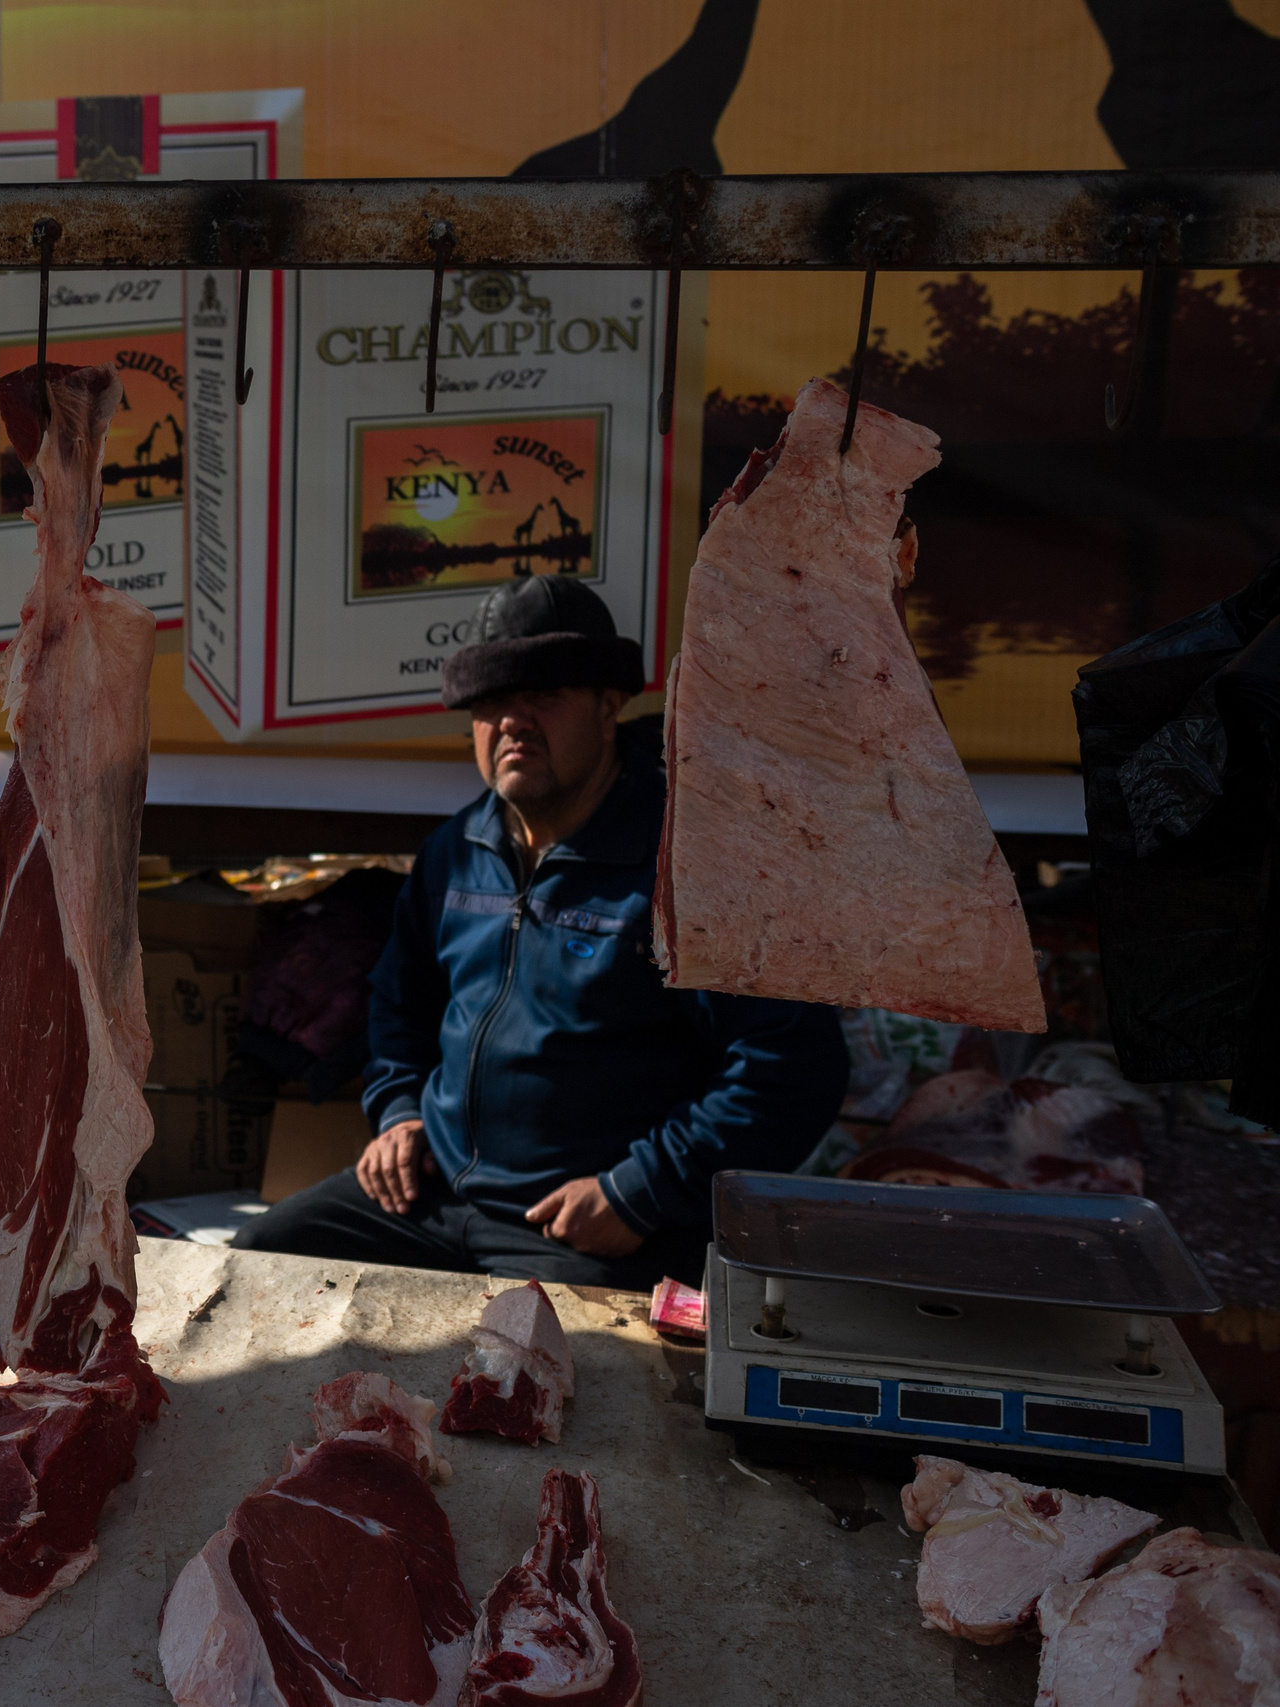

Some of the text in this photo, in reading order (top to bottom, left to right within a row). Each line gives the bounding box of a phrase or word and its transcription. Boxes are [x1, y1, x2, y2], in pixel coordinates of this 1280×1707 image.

[49, 279, 162, 308] Since 1927
[317, 315, 644, 366] CHAMPION
[115, 350, 184, 400] sunse
[484, 367, 547, 391] 1927
[493, 434, 585, 486] sunset
[385, 469, 511, 502] KENYA
[83, 540, 145, 571] OLD
[426, 620, 472, 647] GO
[399, 656, 445, 675] KEN
